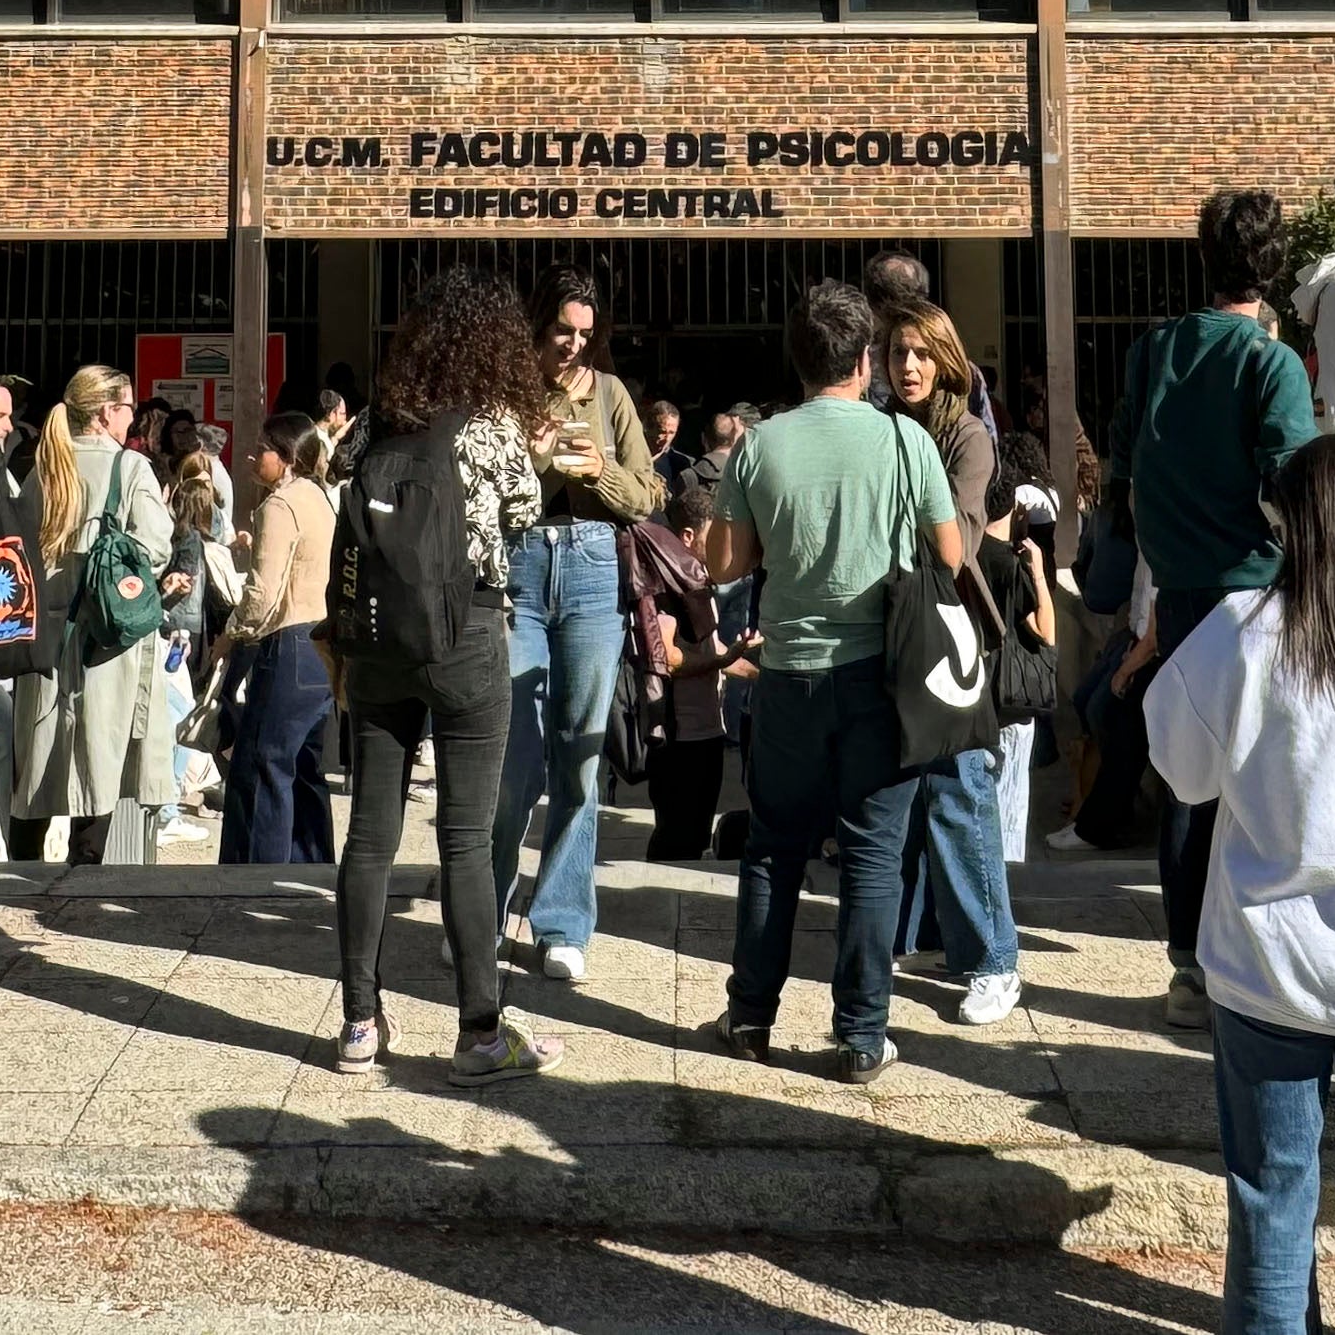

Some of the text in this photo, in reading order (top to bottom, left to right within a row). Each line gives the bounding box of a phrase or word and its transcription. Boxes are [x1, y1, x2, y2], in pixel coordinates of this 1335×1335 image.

[266, 131, 1033, 167] U.C.M. FACULTAD DE PSICOLOGIA
[410, 188, 784, 218] EDIFICIO CENTRAL
